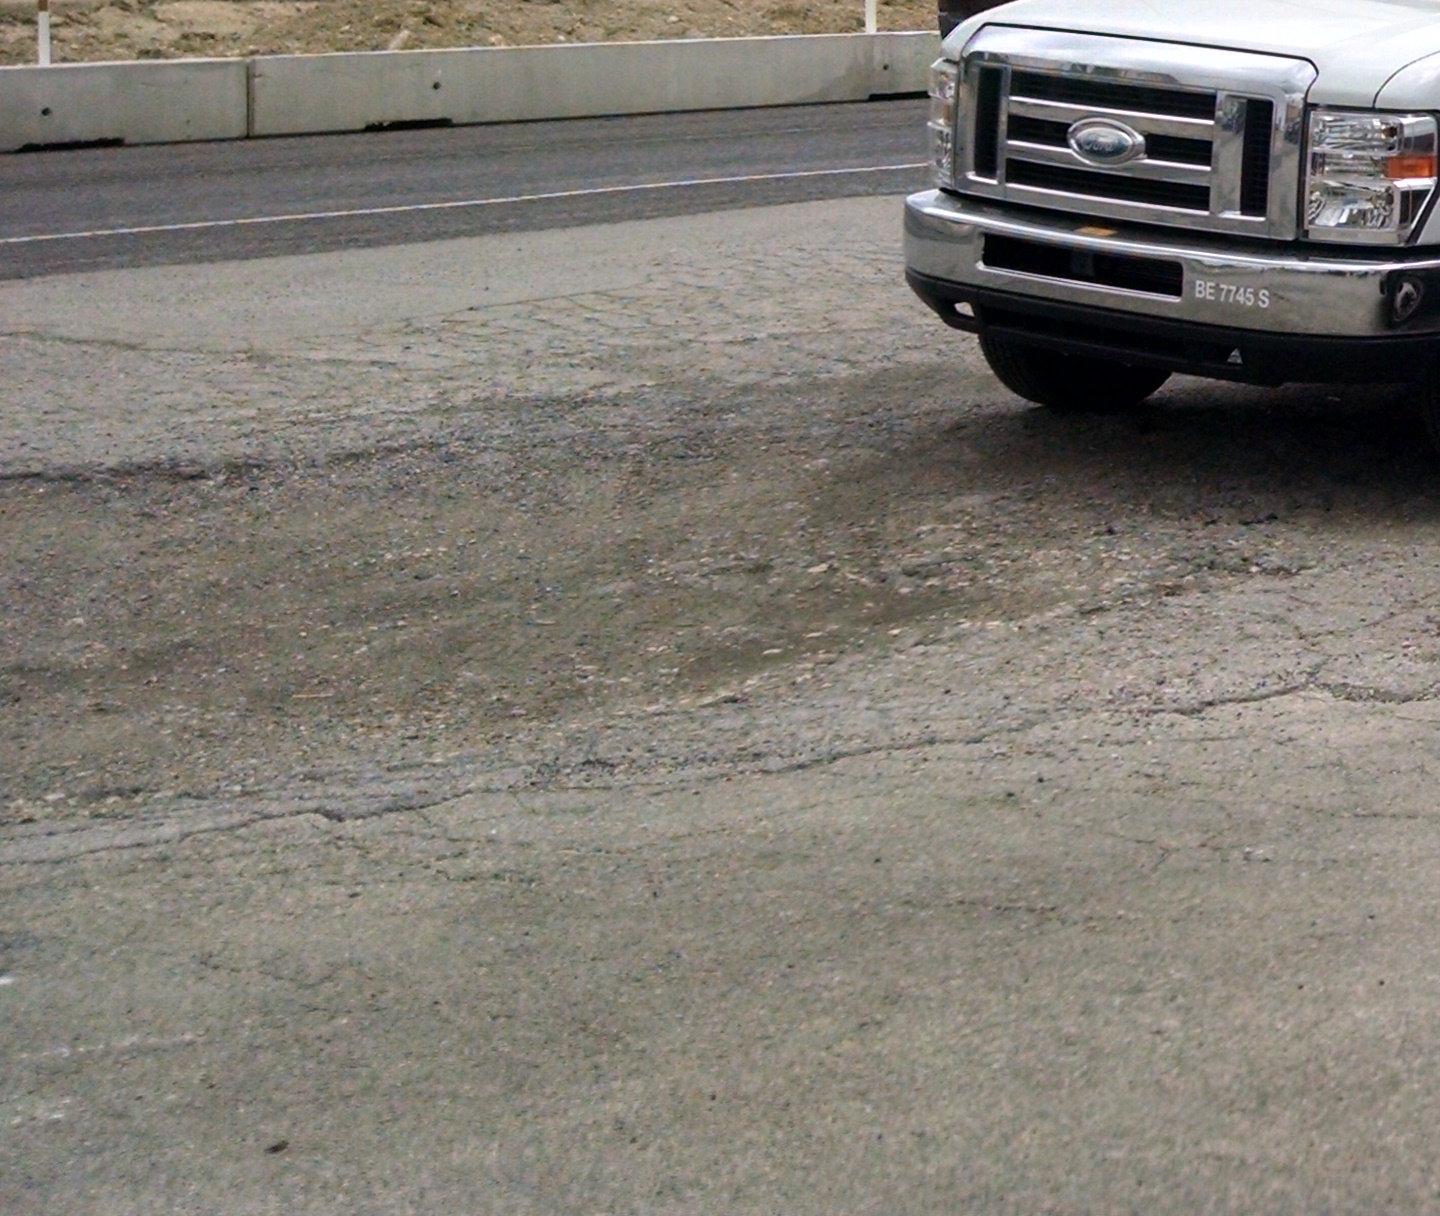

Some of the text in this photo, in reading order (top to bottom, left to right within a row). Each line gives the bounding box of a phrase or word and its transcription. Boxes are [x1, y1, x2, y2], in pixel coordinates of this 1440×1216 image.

[1195, 280, 1270, 308] BE 7745 S
